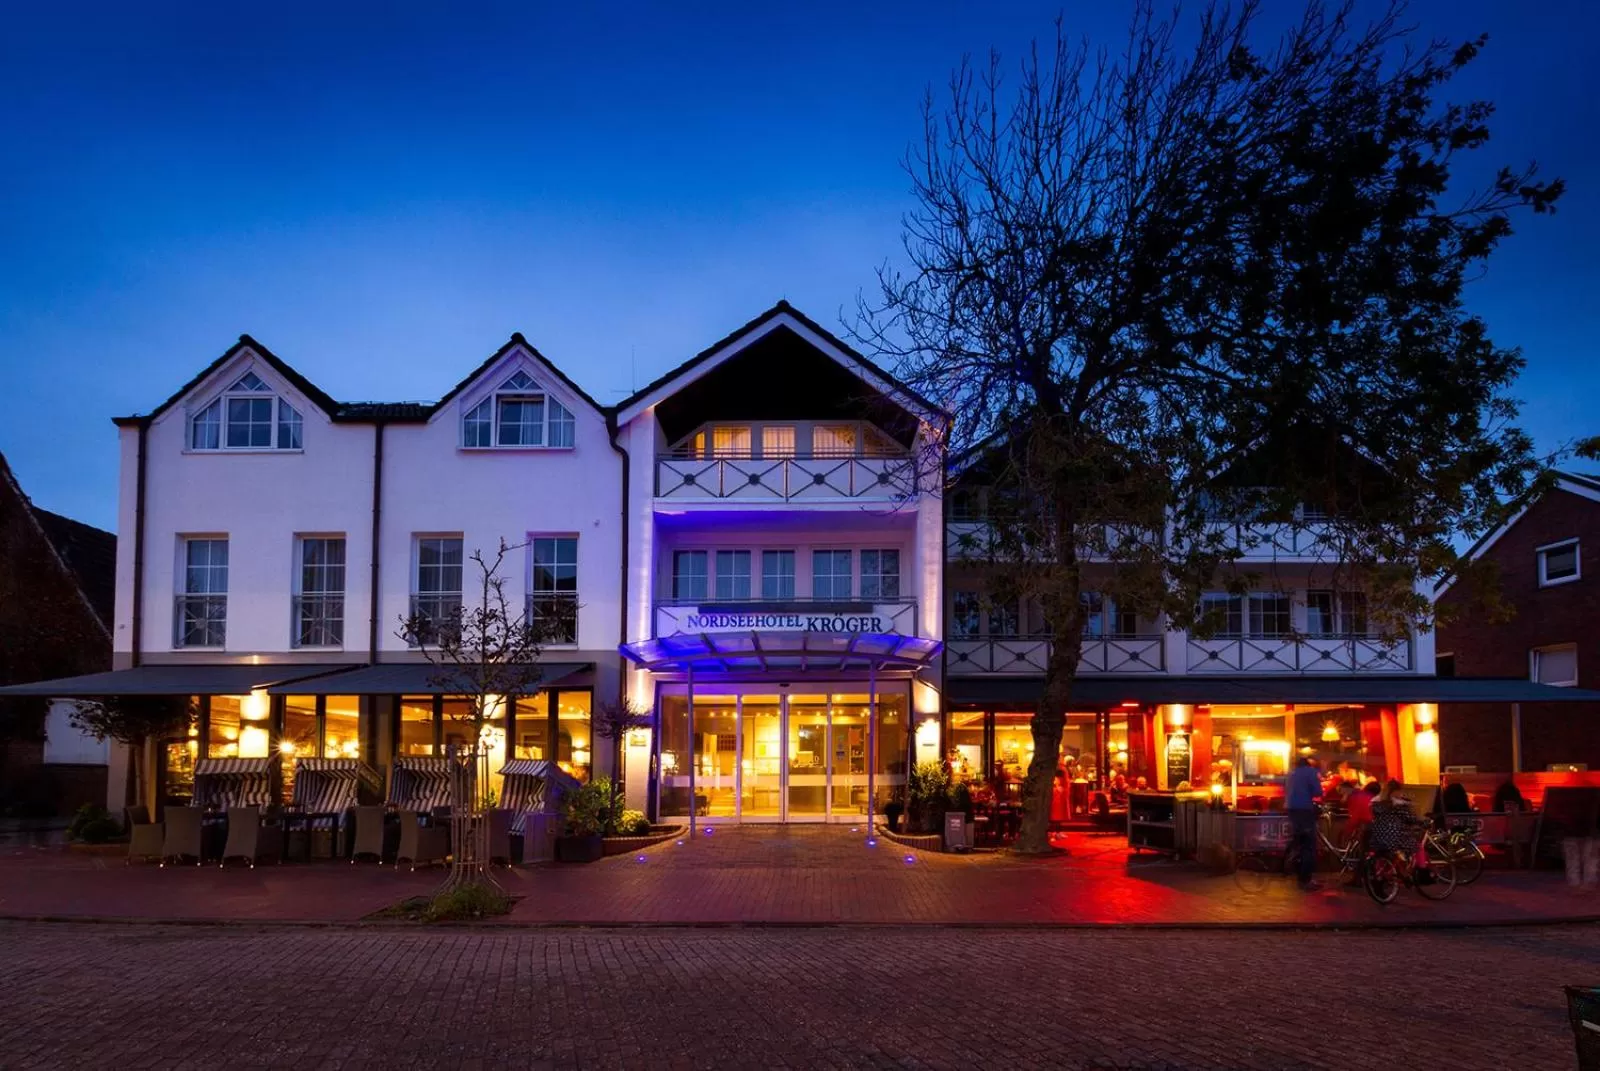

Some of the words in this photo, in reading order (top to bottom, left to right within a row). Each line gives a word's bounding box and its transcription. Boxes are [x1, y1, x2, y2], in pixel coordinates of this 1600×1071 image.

[687, 614, 803, 628] NORDSEEHOTEL
[806, 612, 883, 633] KRÖGER
[1260, 821, 1291, 838] BLIE
